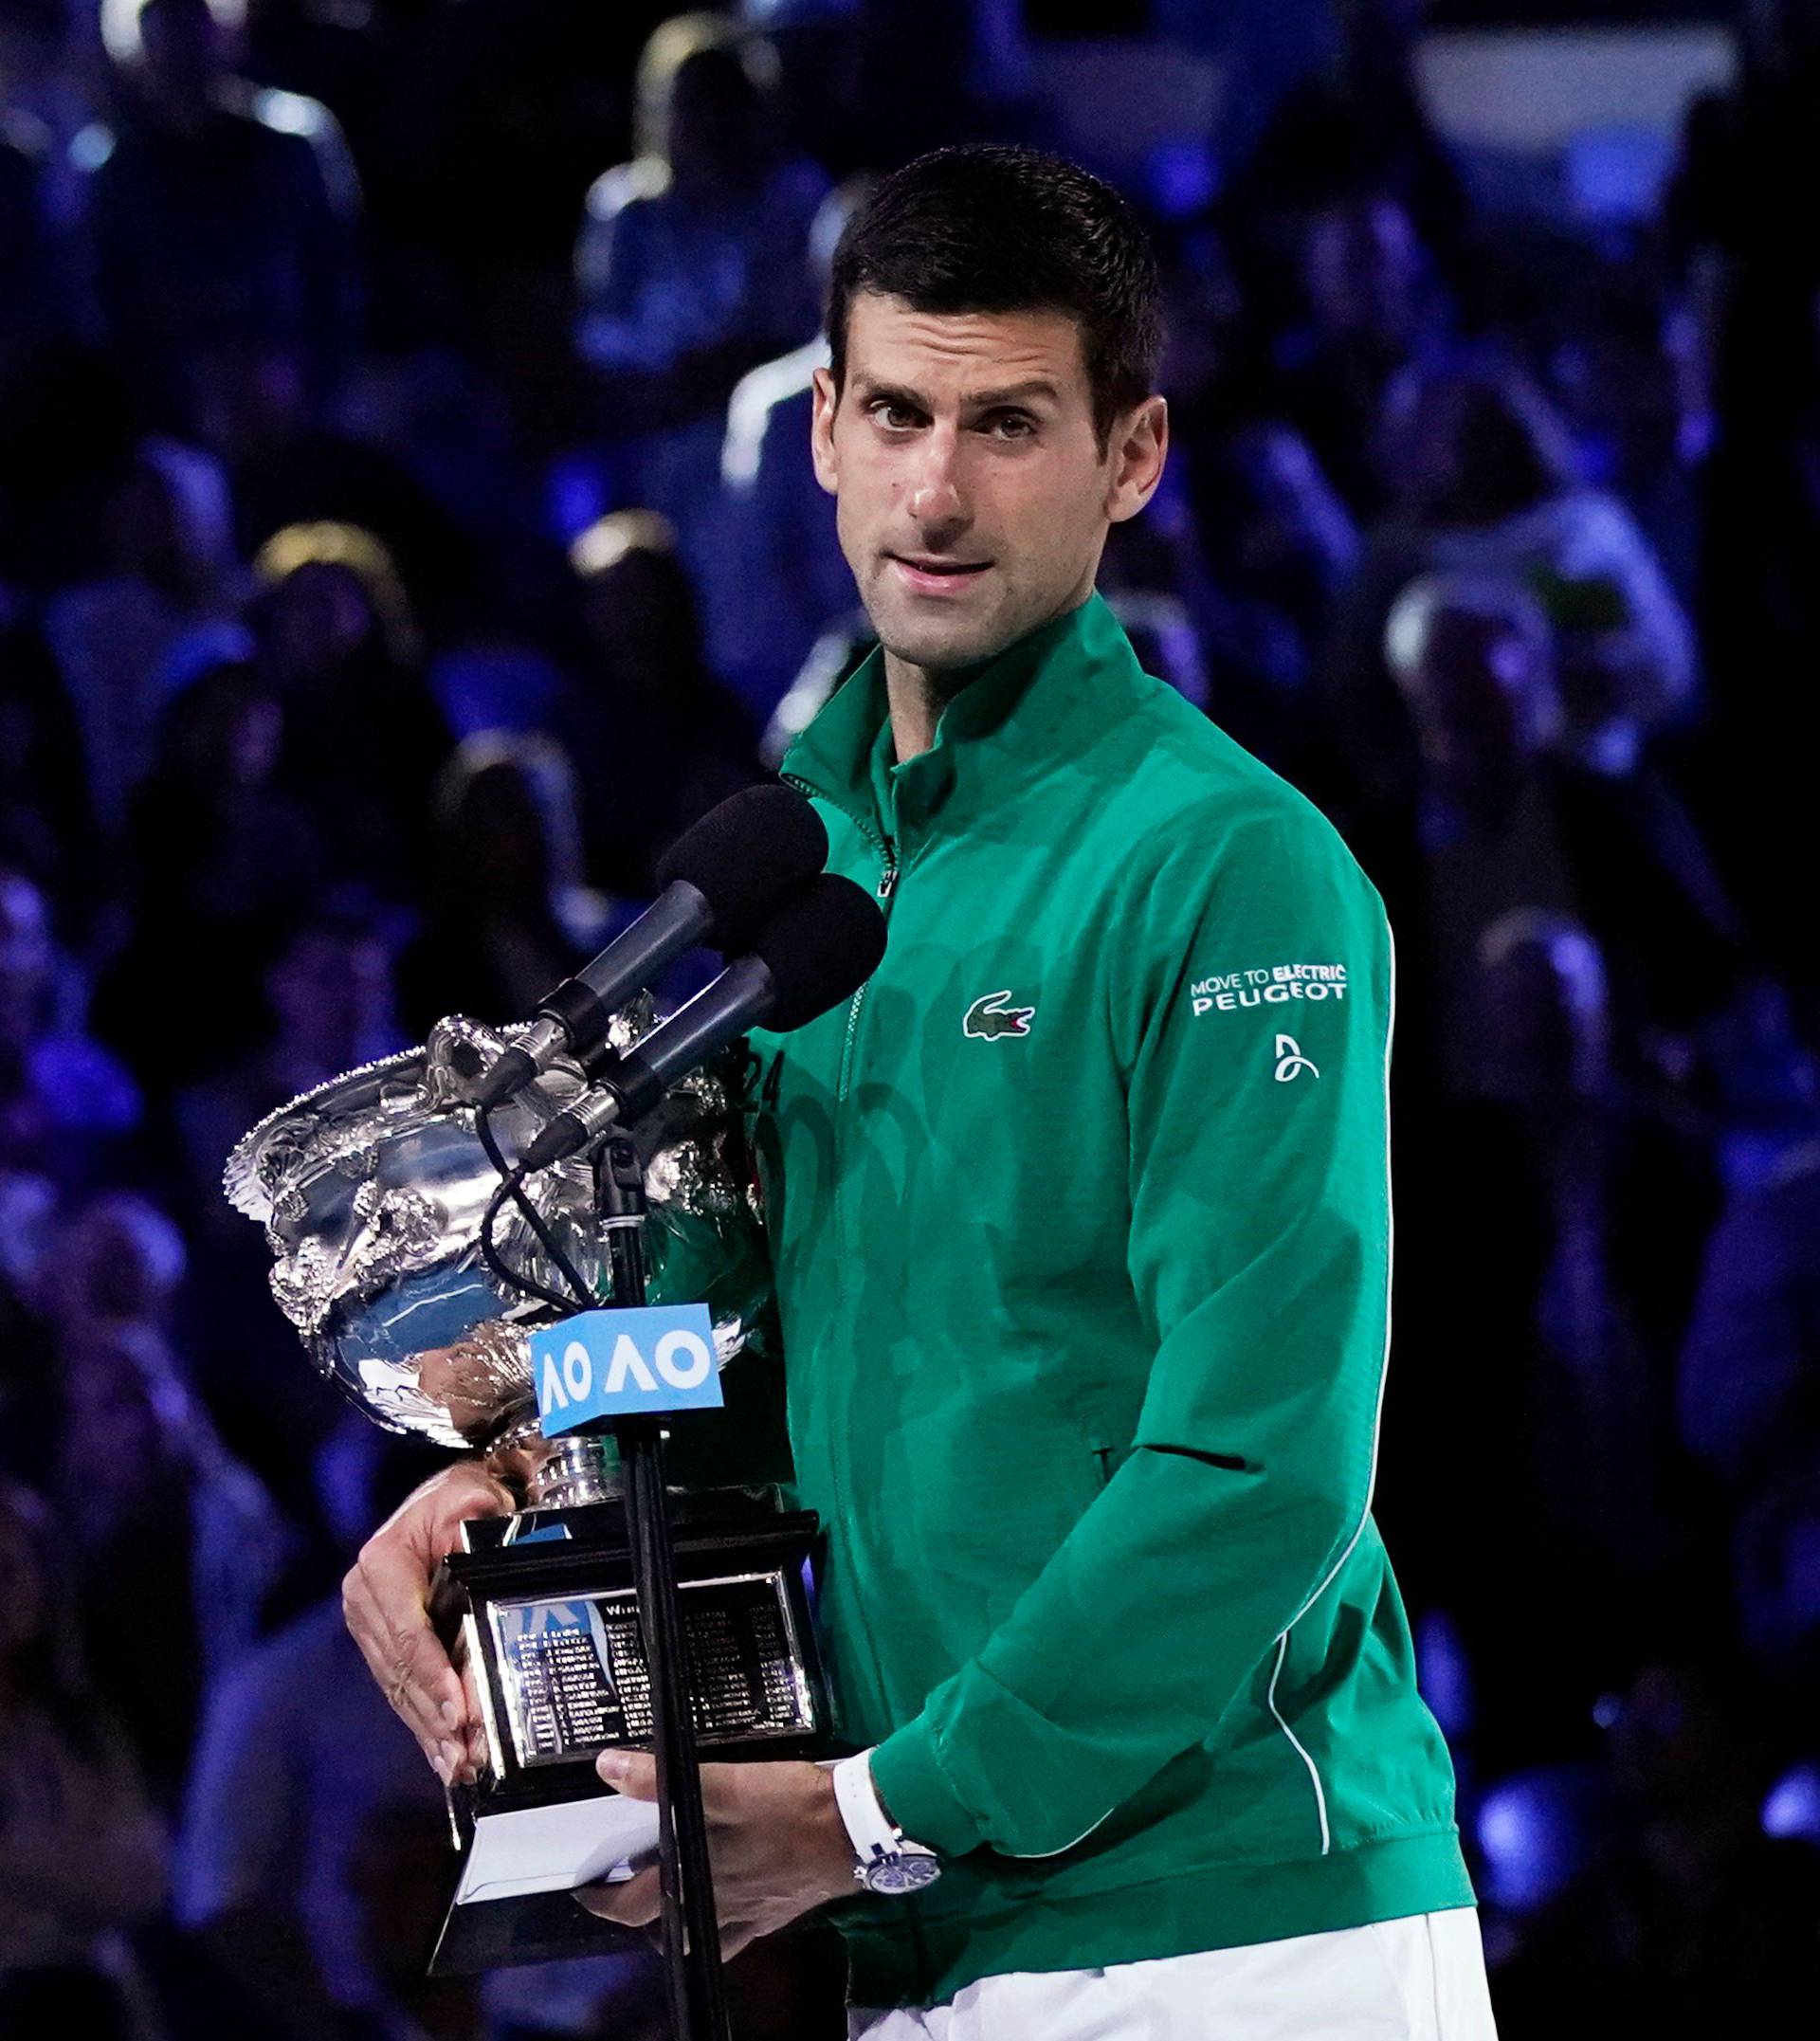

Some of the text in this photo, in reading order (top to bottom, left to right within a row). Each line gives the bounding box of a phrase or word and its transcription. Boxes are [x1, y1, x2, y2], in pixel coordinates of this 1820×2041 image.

[1191, 963, 1348, 998] MOVE TO ELECTRIC
[1192, 981, 1348, 1017] PEUGEOT
[542, 1340, 592, 1416] AO
[604, 1329, 711, 1394] AO
